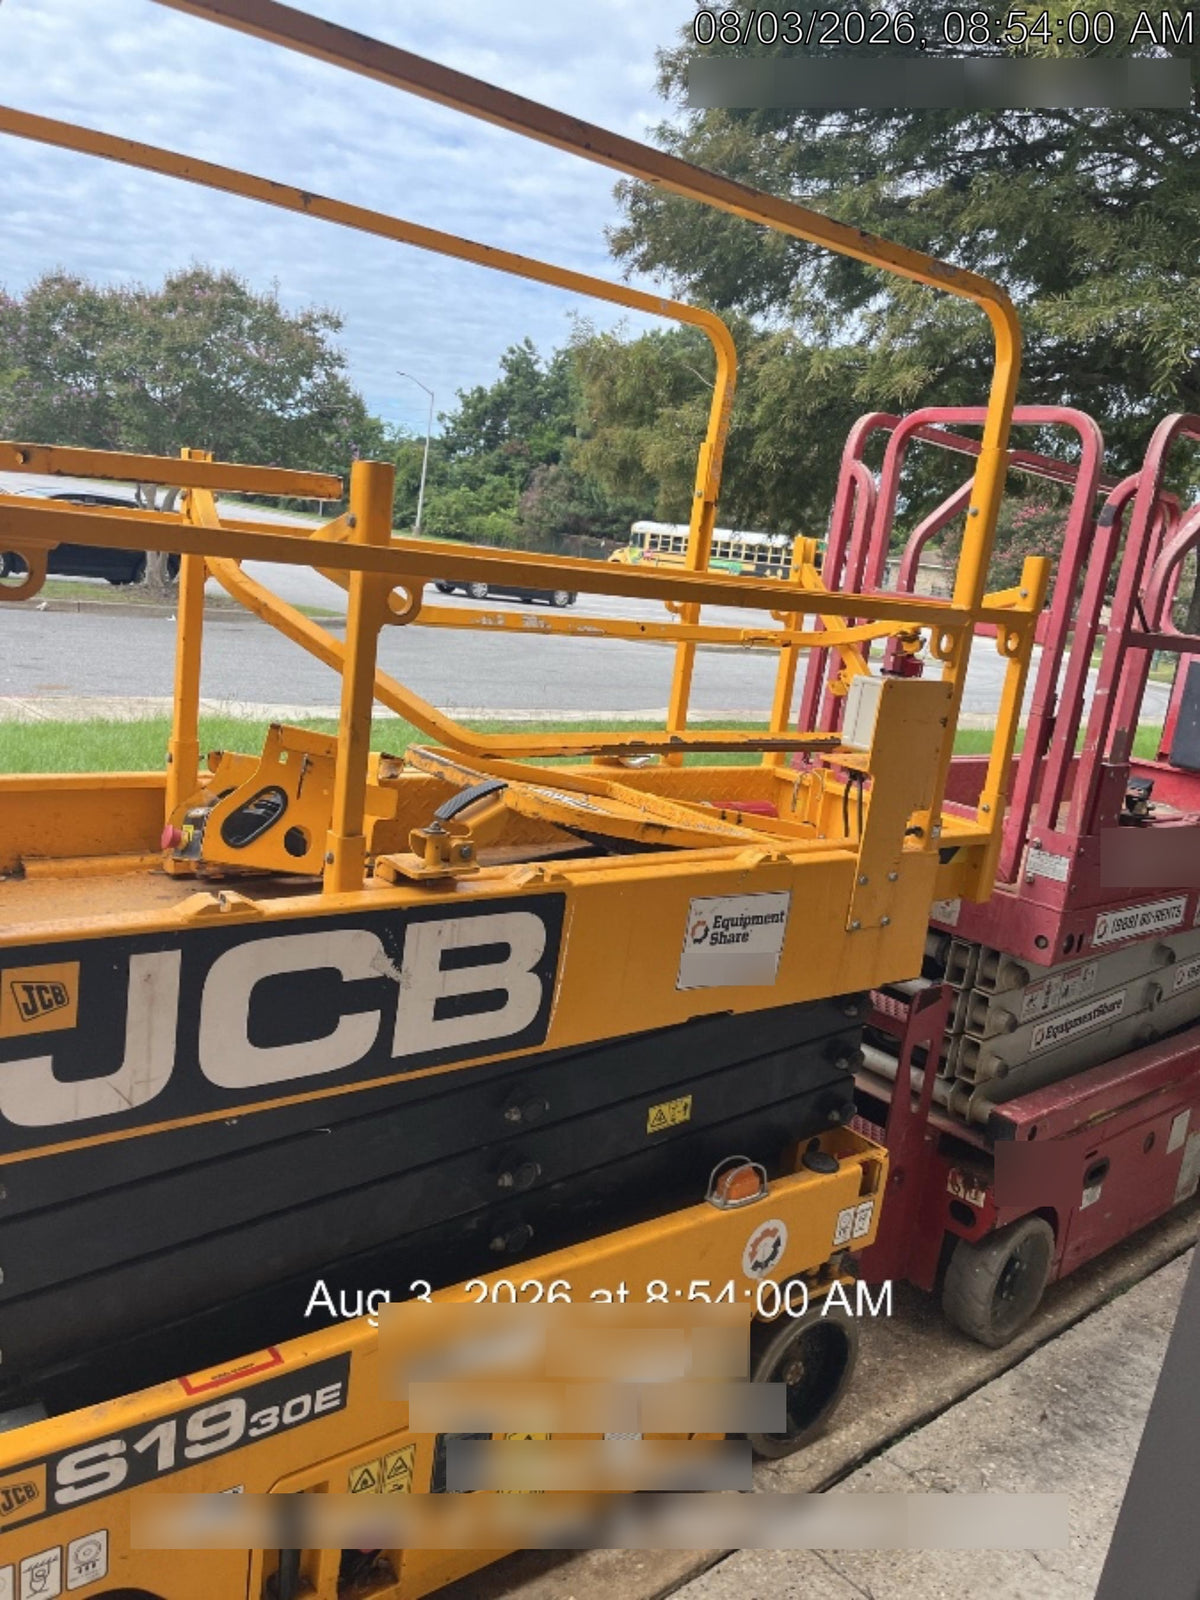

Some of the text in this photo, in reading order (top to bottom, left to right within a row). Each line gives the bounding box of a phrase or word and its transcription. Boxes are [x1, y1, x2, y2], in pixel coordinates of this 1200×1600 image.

[713, 911, 785, 931] Equipment
[709, 931, 750, 946] Share
[21, 984, 66, 1015] JCB
[0, 911, 547, 1127] JCB
[54, 1382, 342, 1504] S1930E
[0, 1483, 37, 1512] JCB
